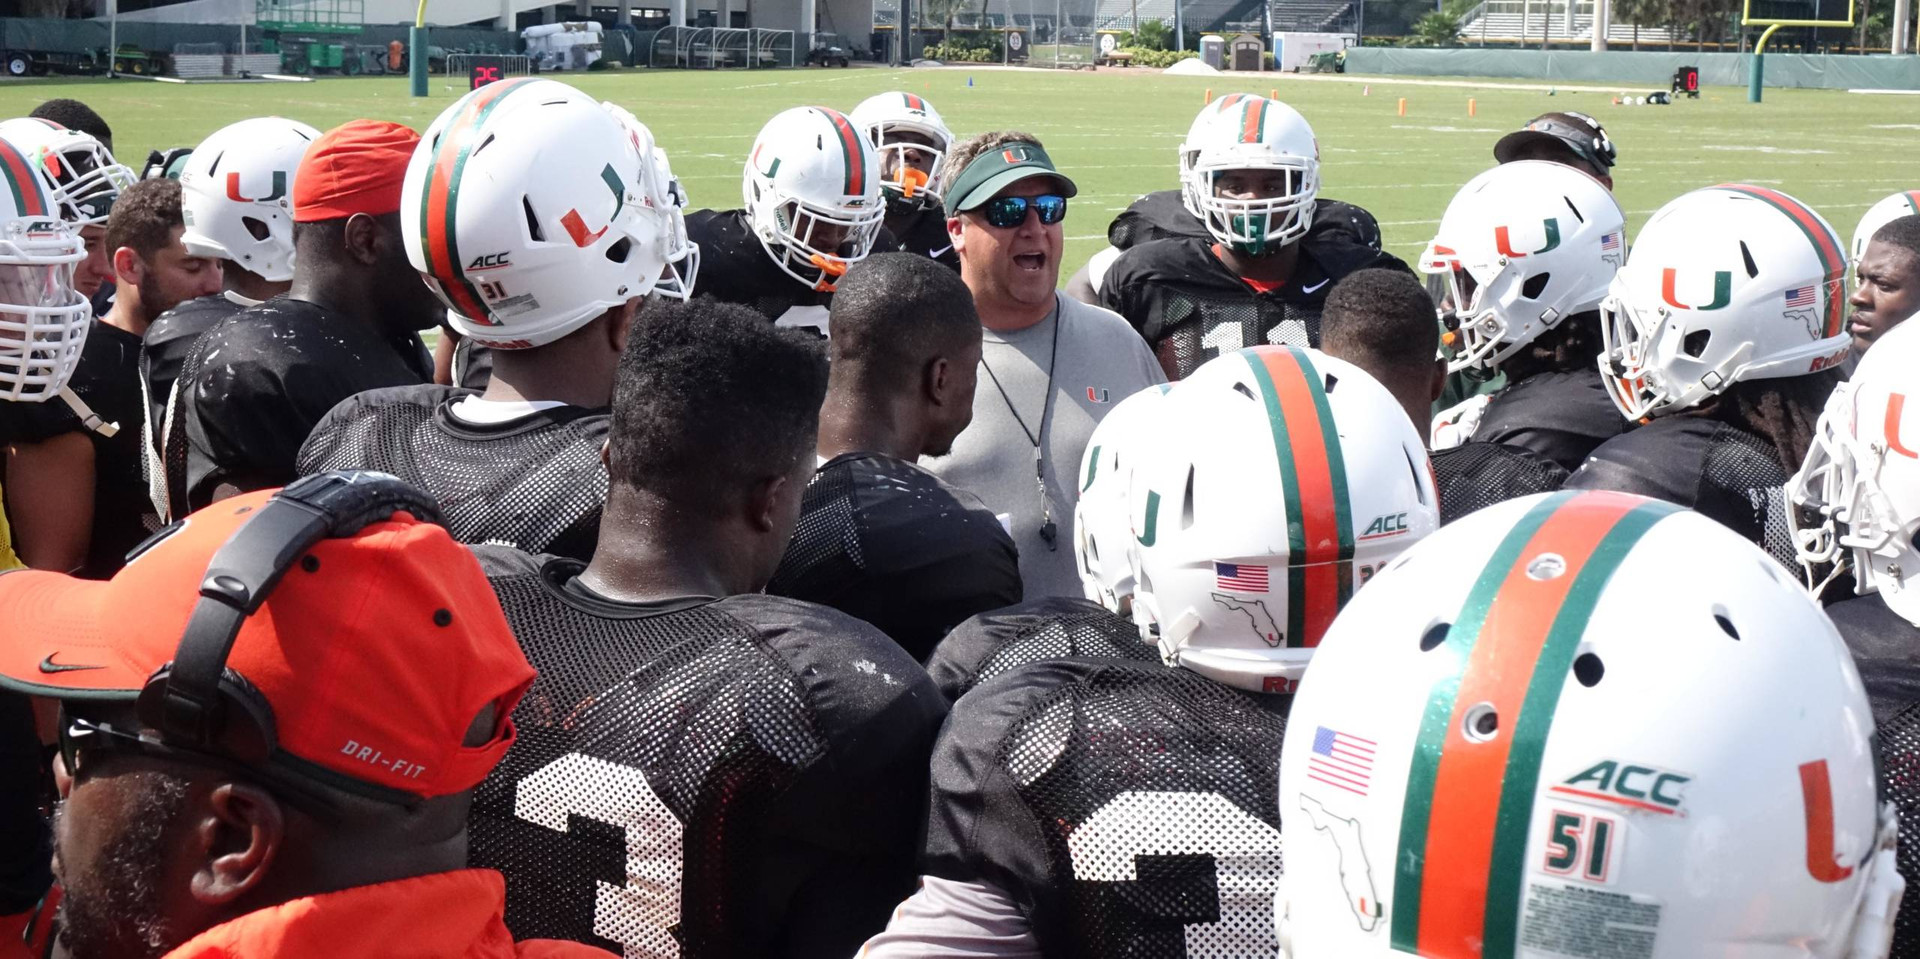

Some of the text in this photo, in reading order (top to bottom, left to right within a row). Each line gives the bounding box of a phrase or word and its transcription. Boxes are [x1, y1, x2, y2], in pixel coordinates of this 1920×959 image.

[1688, 72, 1698, 91] 0
[226, 171, 287, 203] U
[560, 162, 625, 248] U
[1495, 217, 1561, 259] U
[469, 250, 512, 269] ACC
[1661, 268, 1732, 311] U
[1086, 386, 1110, 403] U
[1363, 512, 1408, 535] ACC
[341, 740, 426, 778] DRI-FIT
[1561, 760, 1692, 807] ACC
[1543, 809, 1614, 883] 51
